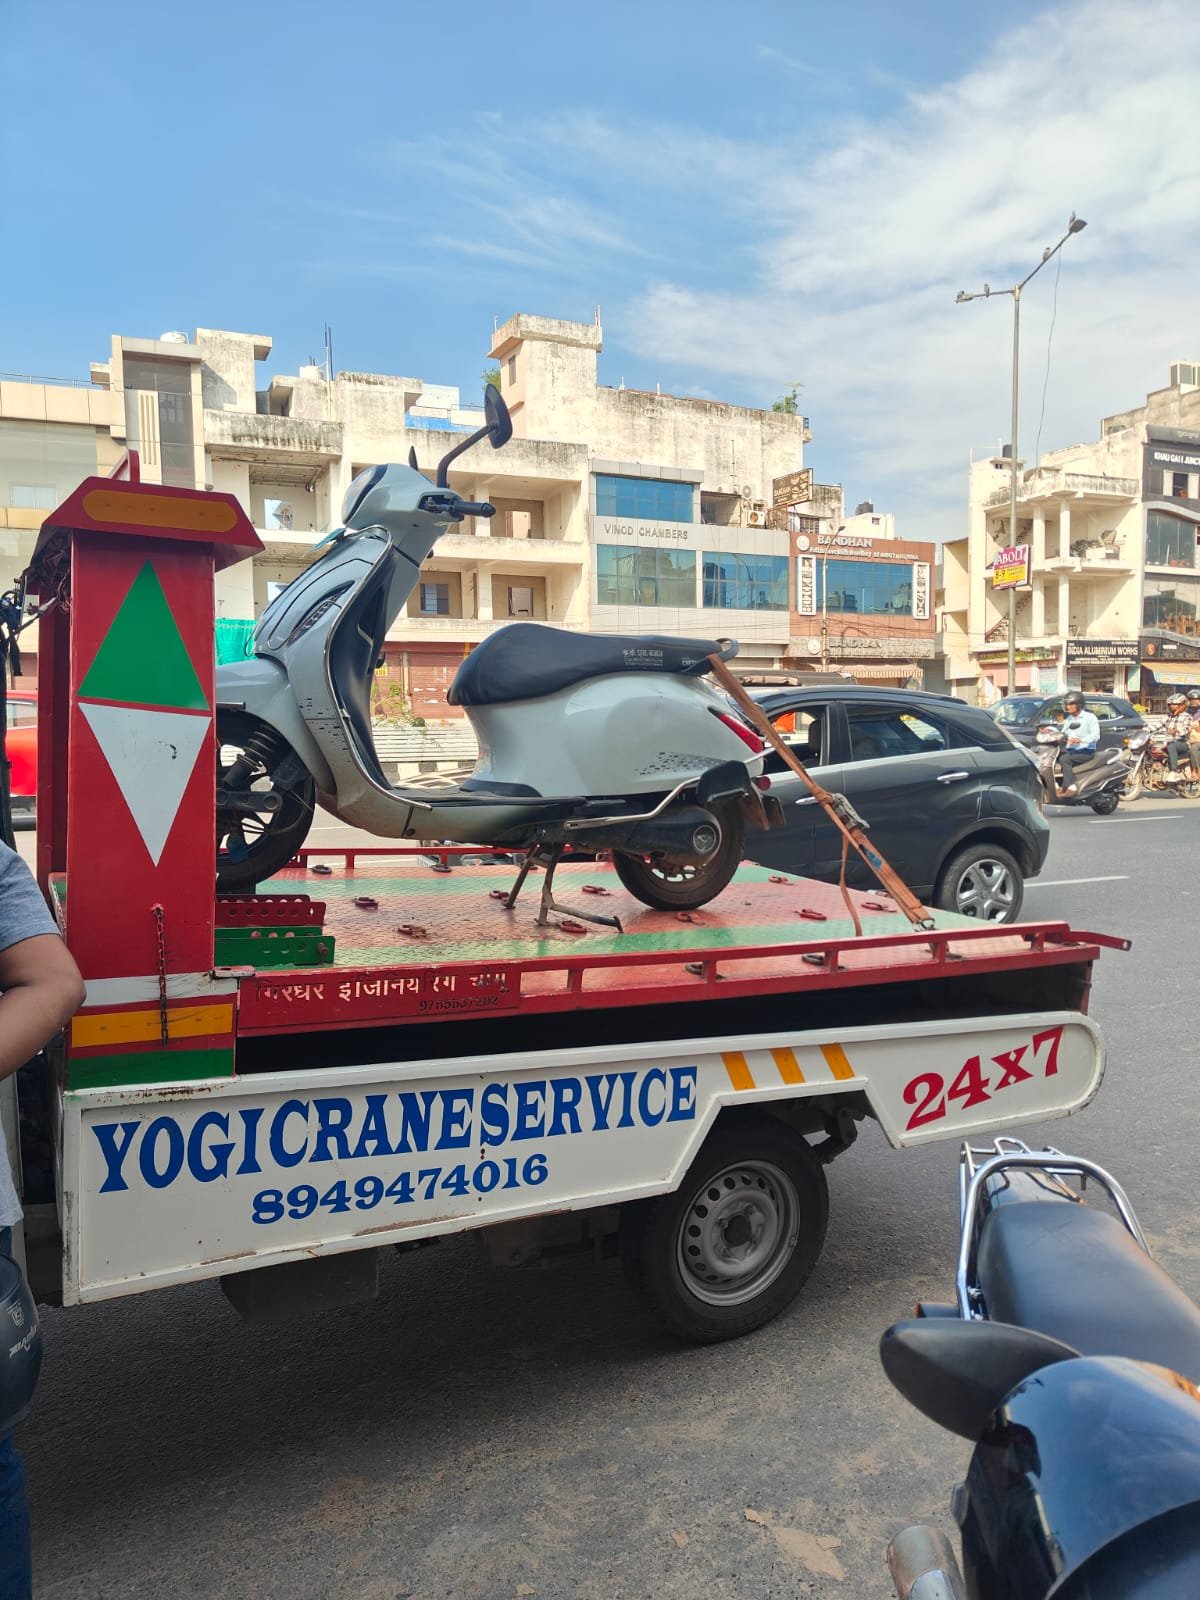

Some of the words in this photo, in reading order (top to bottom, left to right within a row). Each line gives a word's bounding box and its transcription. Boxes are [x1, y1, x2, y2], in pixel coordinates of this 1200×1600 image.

[604, 523, 634, 536] VINOD
[638, 527, 688, 540] CHAMBERS
[817, 535, 873, 548] BANDHAN
[1067, 646, 1084, 656] INDIA
[1117, 646, 1139, 656] WORKS
[251, 1153, 549, 1225] 8949474016
